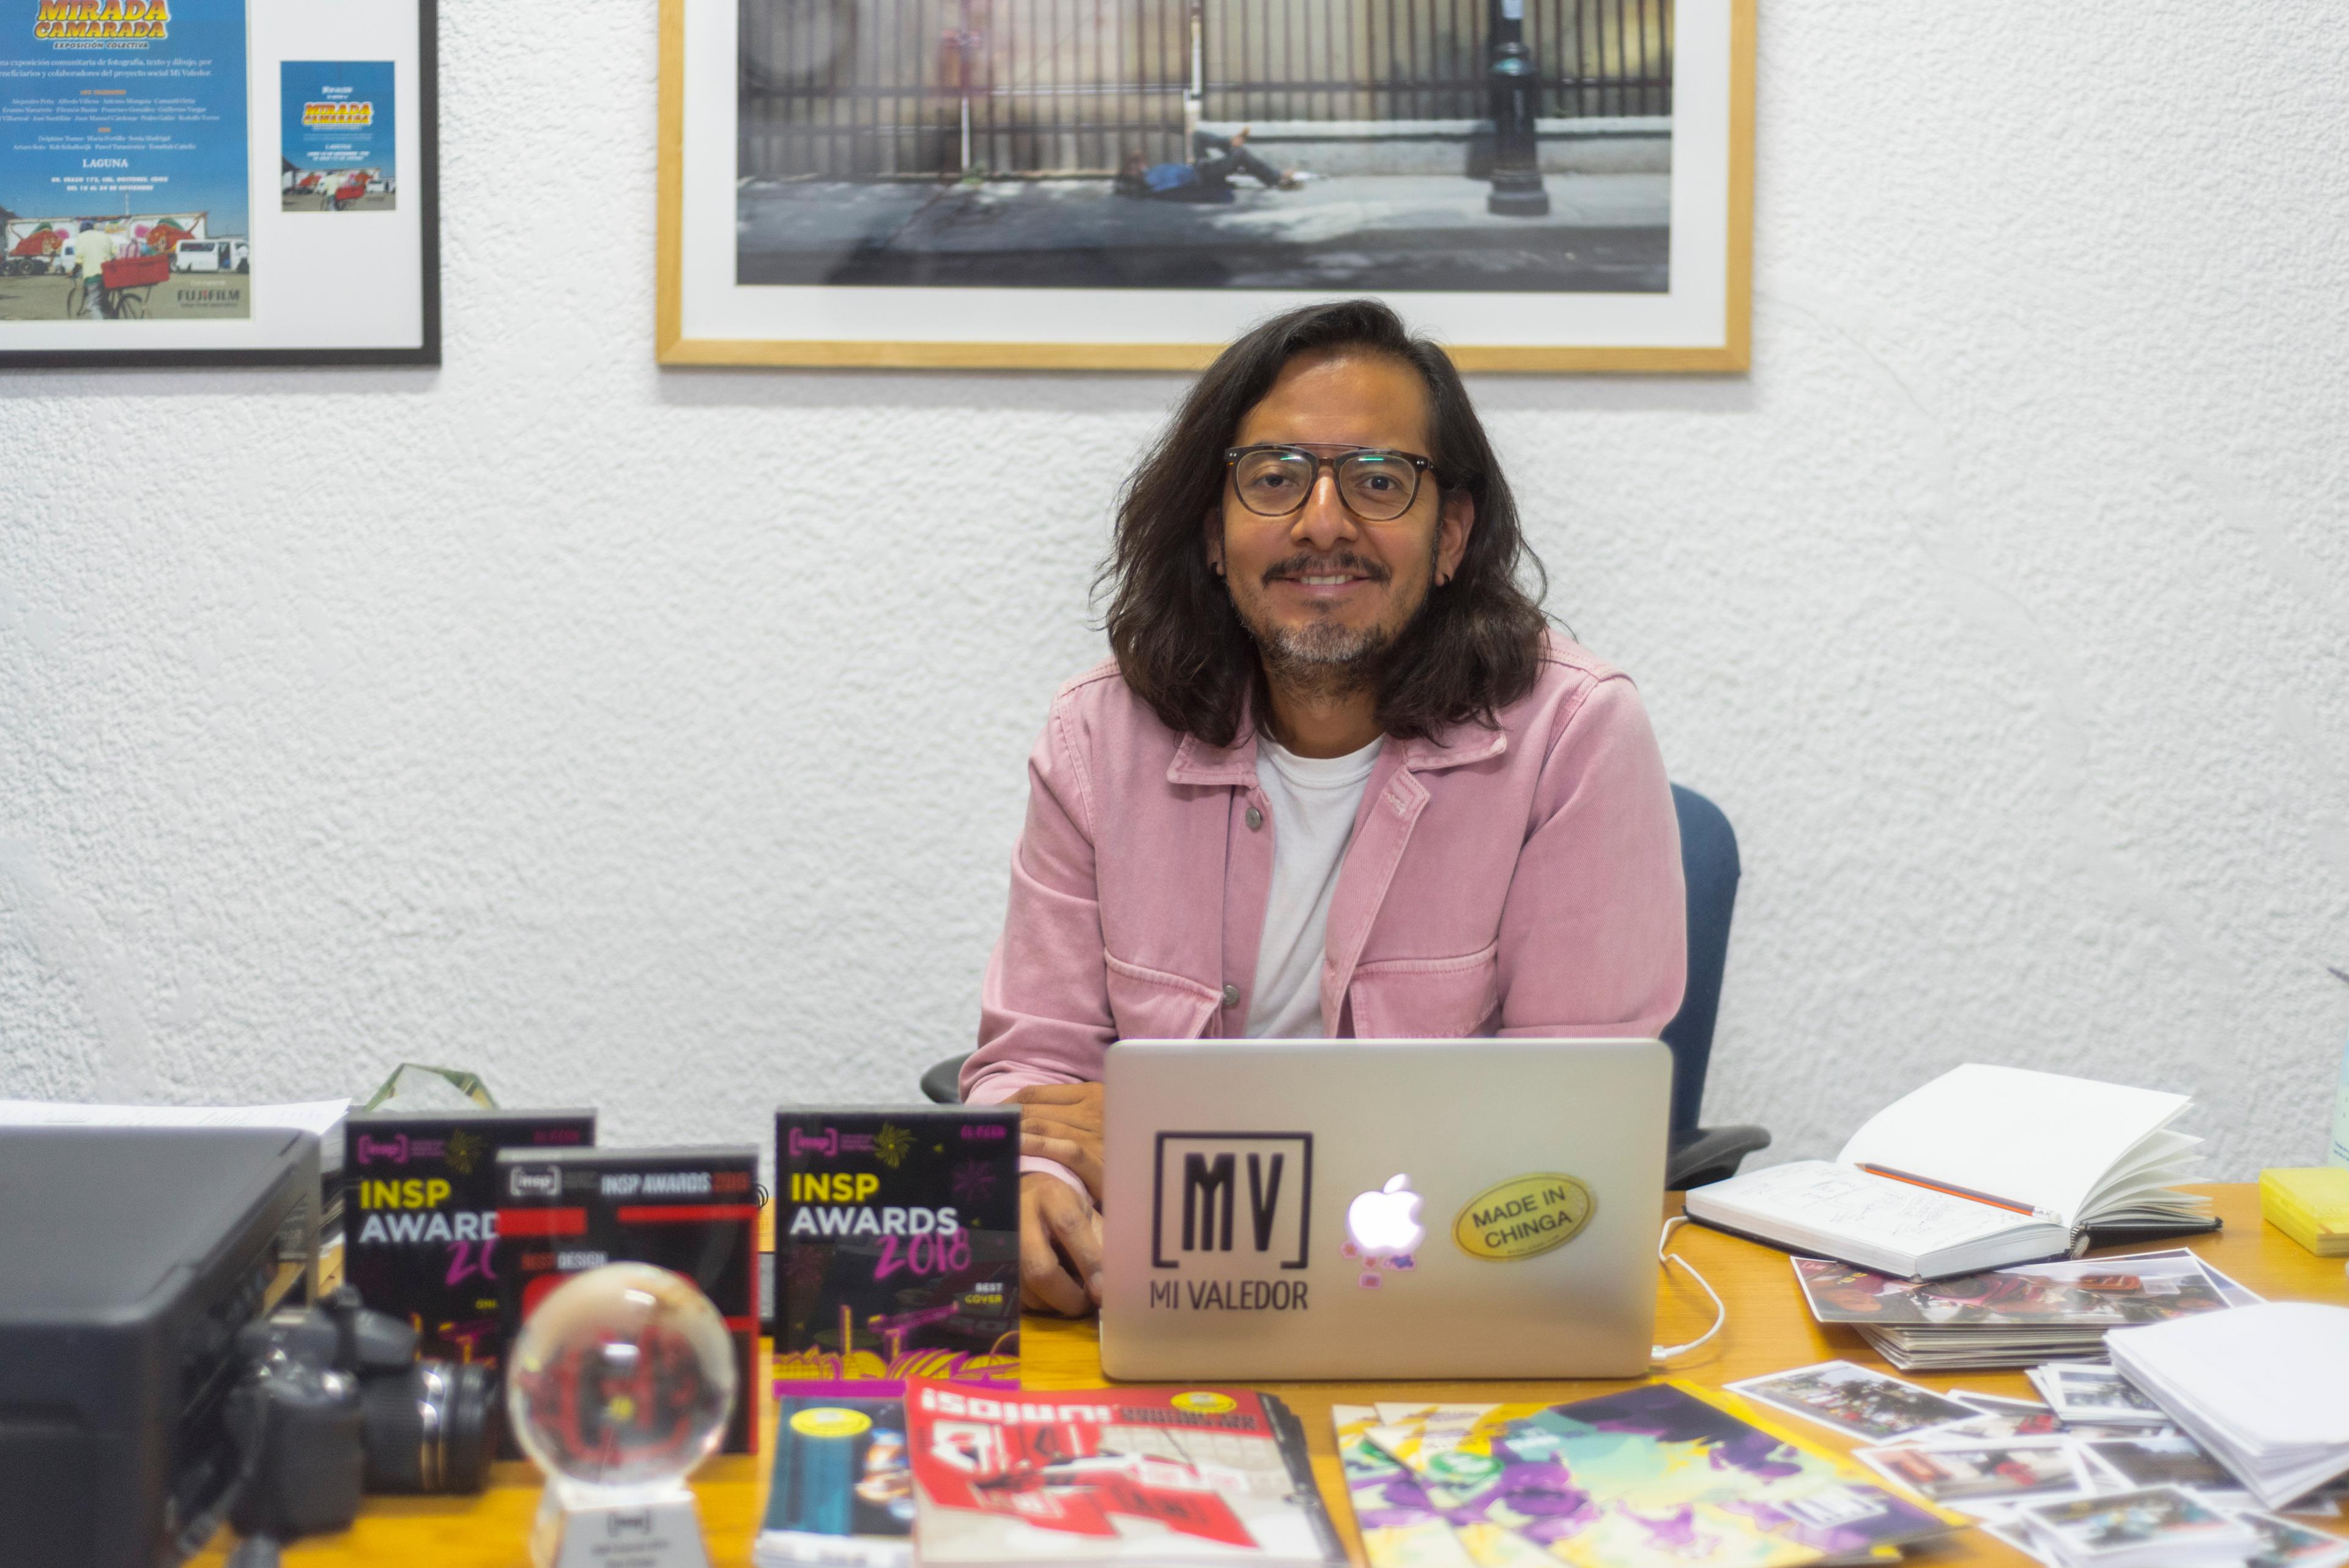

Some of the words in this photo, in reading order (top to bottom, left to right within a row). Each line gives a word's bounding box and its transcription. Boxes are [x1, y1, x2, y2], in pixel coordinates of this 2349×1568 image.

[38, 0, 167, 20] MIRADA
[35, 21, 165, 38] CAMARADA
[83, 158, 128, 168] LAGUNA
[177, 289, 240, 301] FUJIFILM
[360, 1178, 451, 1209] INSP
[601, 1173, 639, 1195] INSP
[642, 1172, 711, 1194] AWARDS
[791, 1173, 880, 1203] INSP
[1183, 1152, 1284, 1252] MV
[1472, 1194, 1538, 1228] MADE
[1542, 1185, 1566, 1206] IN
[359, 1211, 499, 1243] AWARD
[790, 1206, 959, 1235] AWARDS
[1484, 1209, 1573, 1249] CHINGA
[557, 1251, 608, 1270] DESIGN
[873, 1226, 971, 1280] 2018
[965, 1294, 1004, 1304] COVER
[976, 1283, 1004, 1293] BEST
[1149, 1280, 1179, 1310] MI
[1187, 1279, 1308, 1310] VALEDOR
